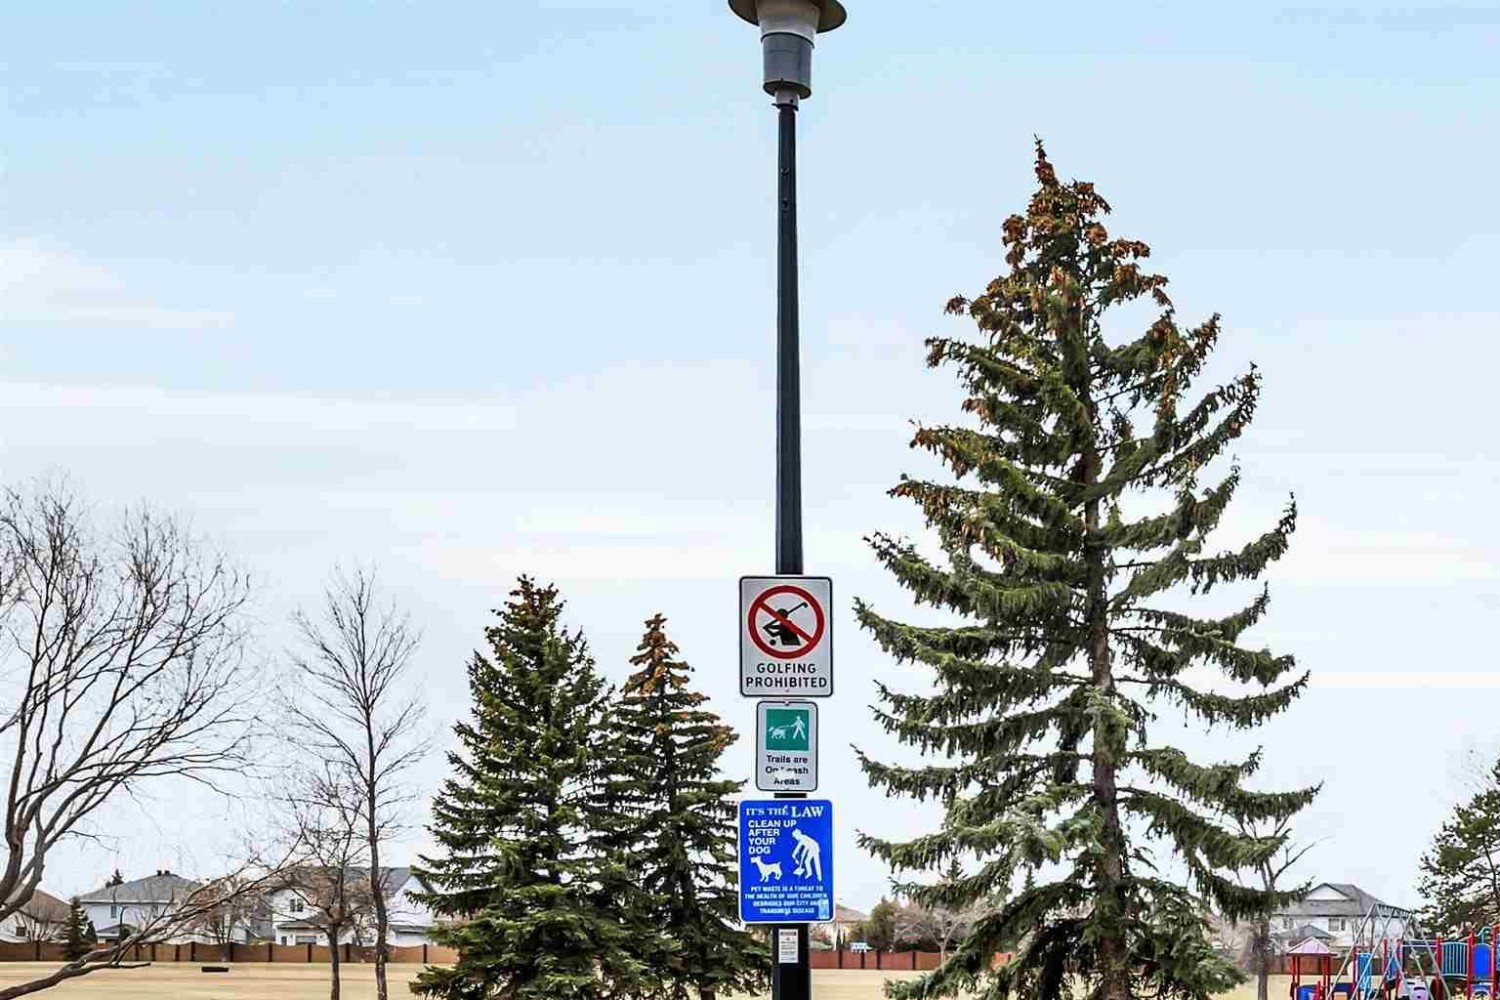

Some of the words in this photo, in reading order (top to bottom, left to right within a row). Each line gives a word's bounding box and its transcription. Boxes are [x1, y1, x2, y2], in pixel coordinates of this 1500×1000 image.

[757, 663, 816, 674] GOLFING
[746, 677, 827, 688] PROHIBITED
[766, 755, 791, 763] Trails
[780, 766, 809, 774] ash
[766, 807, 788, 816] THE
[791, 805, 824, 817] LAW
[748, 820, 781, 828] CLEAN
[783, 820, 797, 828] UP
[748, 828, 780, 836] AFTER
[748, 837, 776, 845] YOUR
[748, 846, 771, 854] DOG
